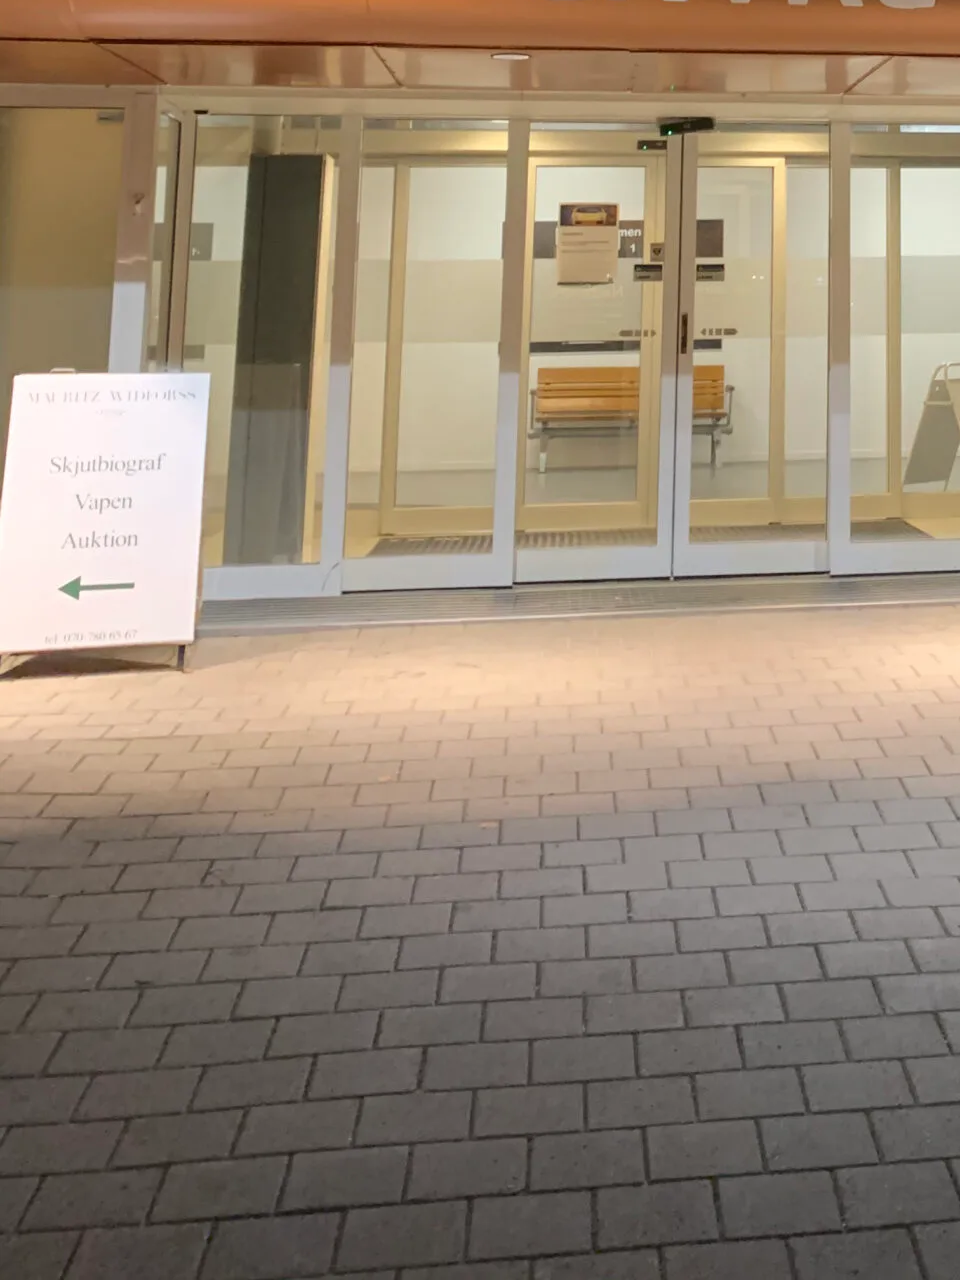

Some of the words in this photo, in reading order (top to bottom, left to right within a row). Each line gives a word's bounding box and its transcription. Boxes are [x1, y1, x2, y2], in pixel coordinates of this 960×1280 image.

[49, 453, 166, 478] Skjutbiograf
[74, 492, 133, 514] Vapen
[61, 529, 139, 550] Auktion
